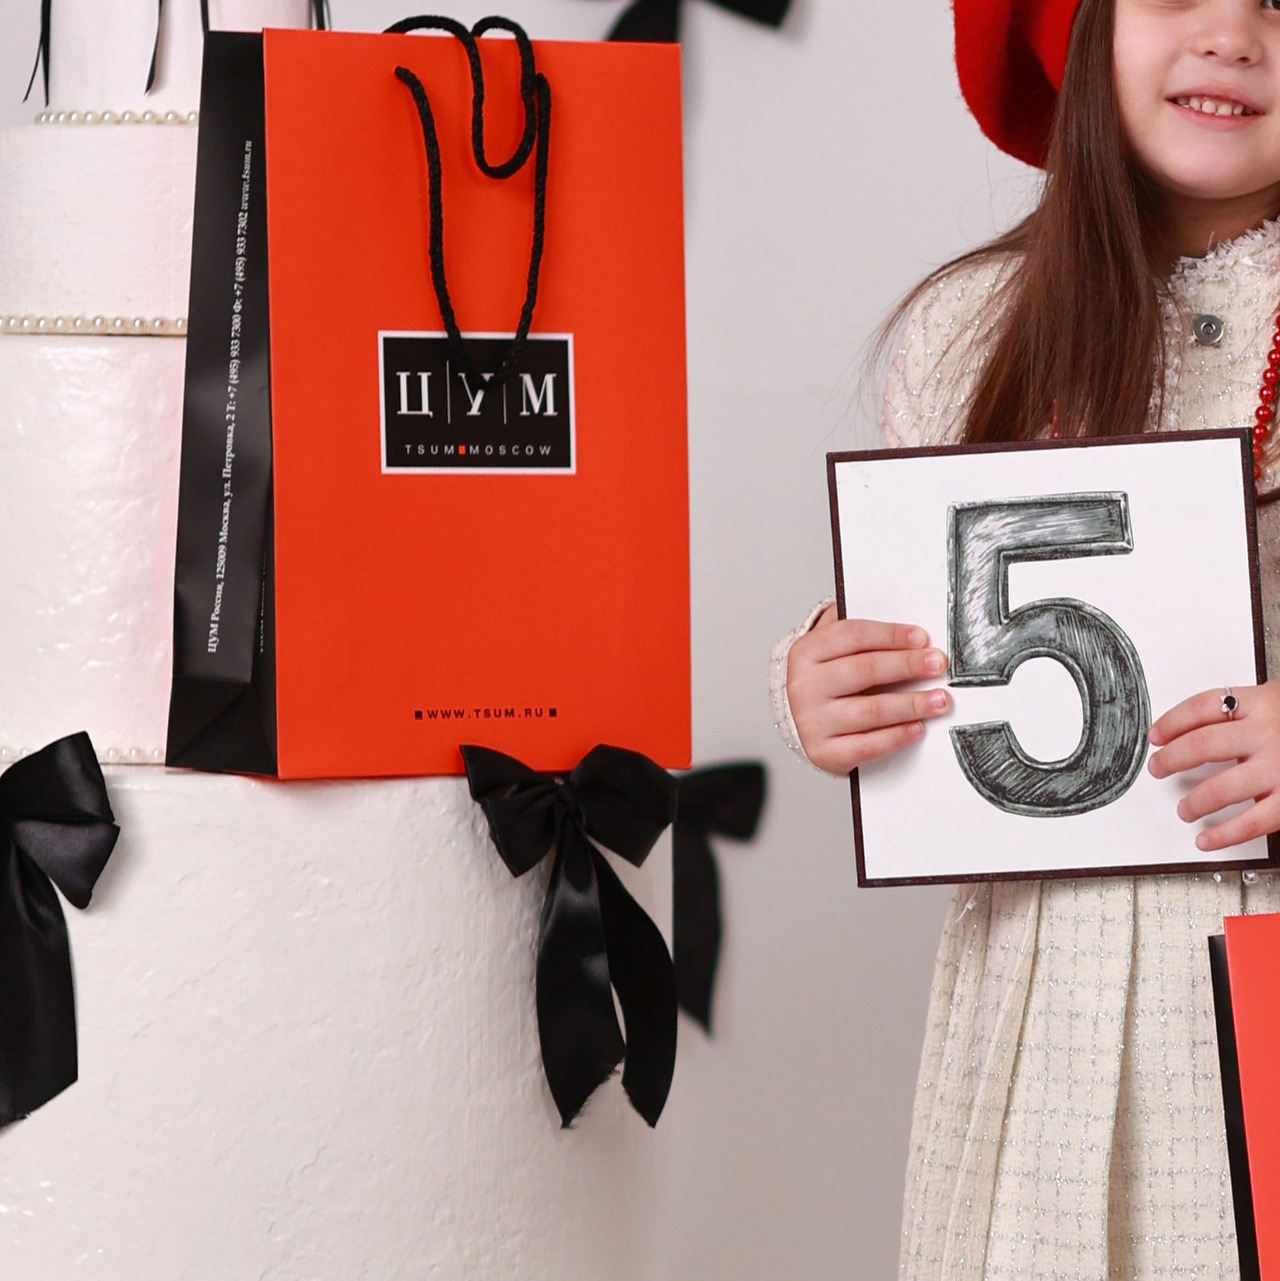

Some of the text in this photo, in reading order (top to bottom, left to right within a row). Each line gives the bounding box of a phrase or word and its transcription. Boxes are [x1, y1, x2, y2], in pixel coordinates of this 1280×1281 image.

[237, 212, 249, 236] 7302
[236, 237, 247, 256] 933
[235, 256, 247, 282] (495)
[234, 283, 244, 298] +7
[233, 299, 243, 314] Ф:
[231, 314, 242, 338] 7300
[230, 339, 241, 358] 933
[229, 359, 242, 385] (495)
[227, 385, 238, 400] +7
[396, 372, 558, 418] ЦУМ
[225, 414, 235, 422] 2
[222, 423, 236, 478] Петровка,
[405, 445, 551, 456] TSUM MOSCOW
[222, 480, 234, 498] ул.
[218, 499, 232, 543] Москва,
[215, 544, 228, 580] 125009
[210, 581, 225, 622] Россия,
[207, 623, 220, 653] ЦУМ
[946, 491, 1153, 818] 5
[427, 708, 543, 719] WWW.TSUM.RU
